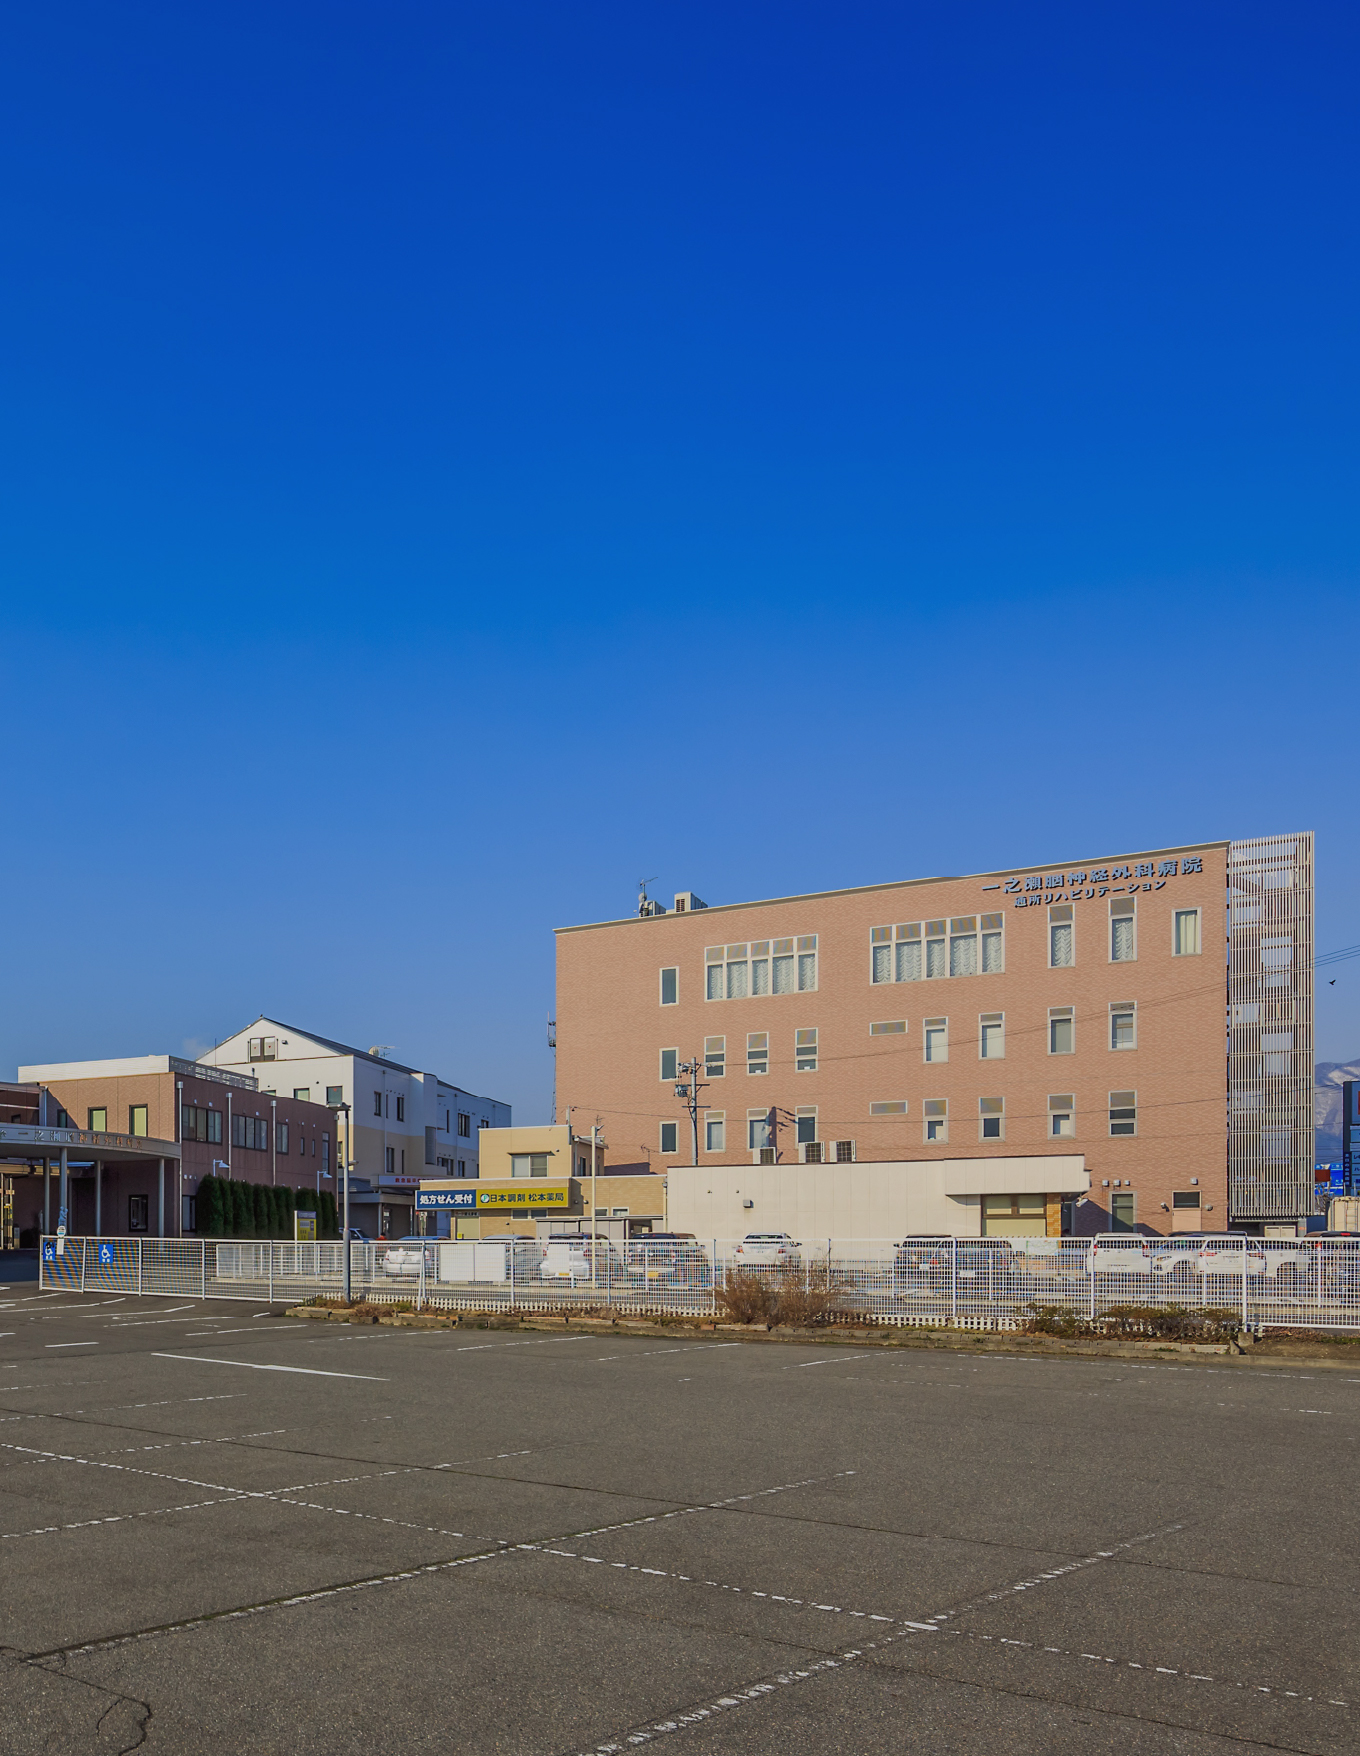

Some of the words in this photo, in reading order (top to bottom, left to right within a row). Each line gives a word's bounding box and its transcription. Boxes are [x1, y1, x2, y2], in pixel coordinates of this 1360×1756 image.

[1014, 879, 1167, 908] 通所リハビリテーション
[419, 1193, 473, 1205] 処方せん受付
[490, 1193, 526, 1204] 日本調剤
[528, 1192, 565, 1203] 松本薬局
